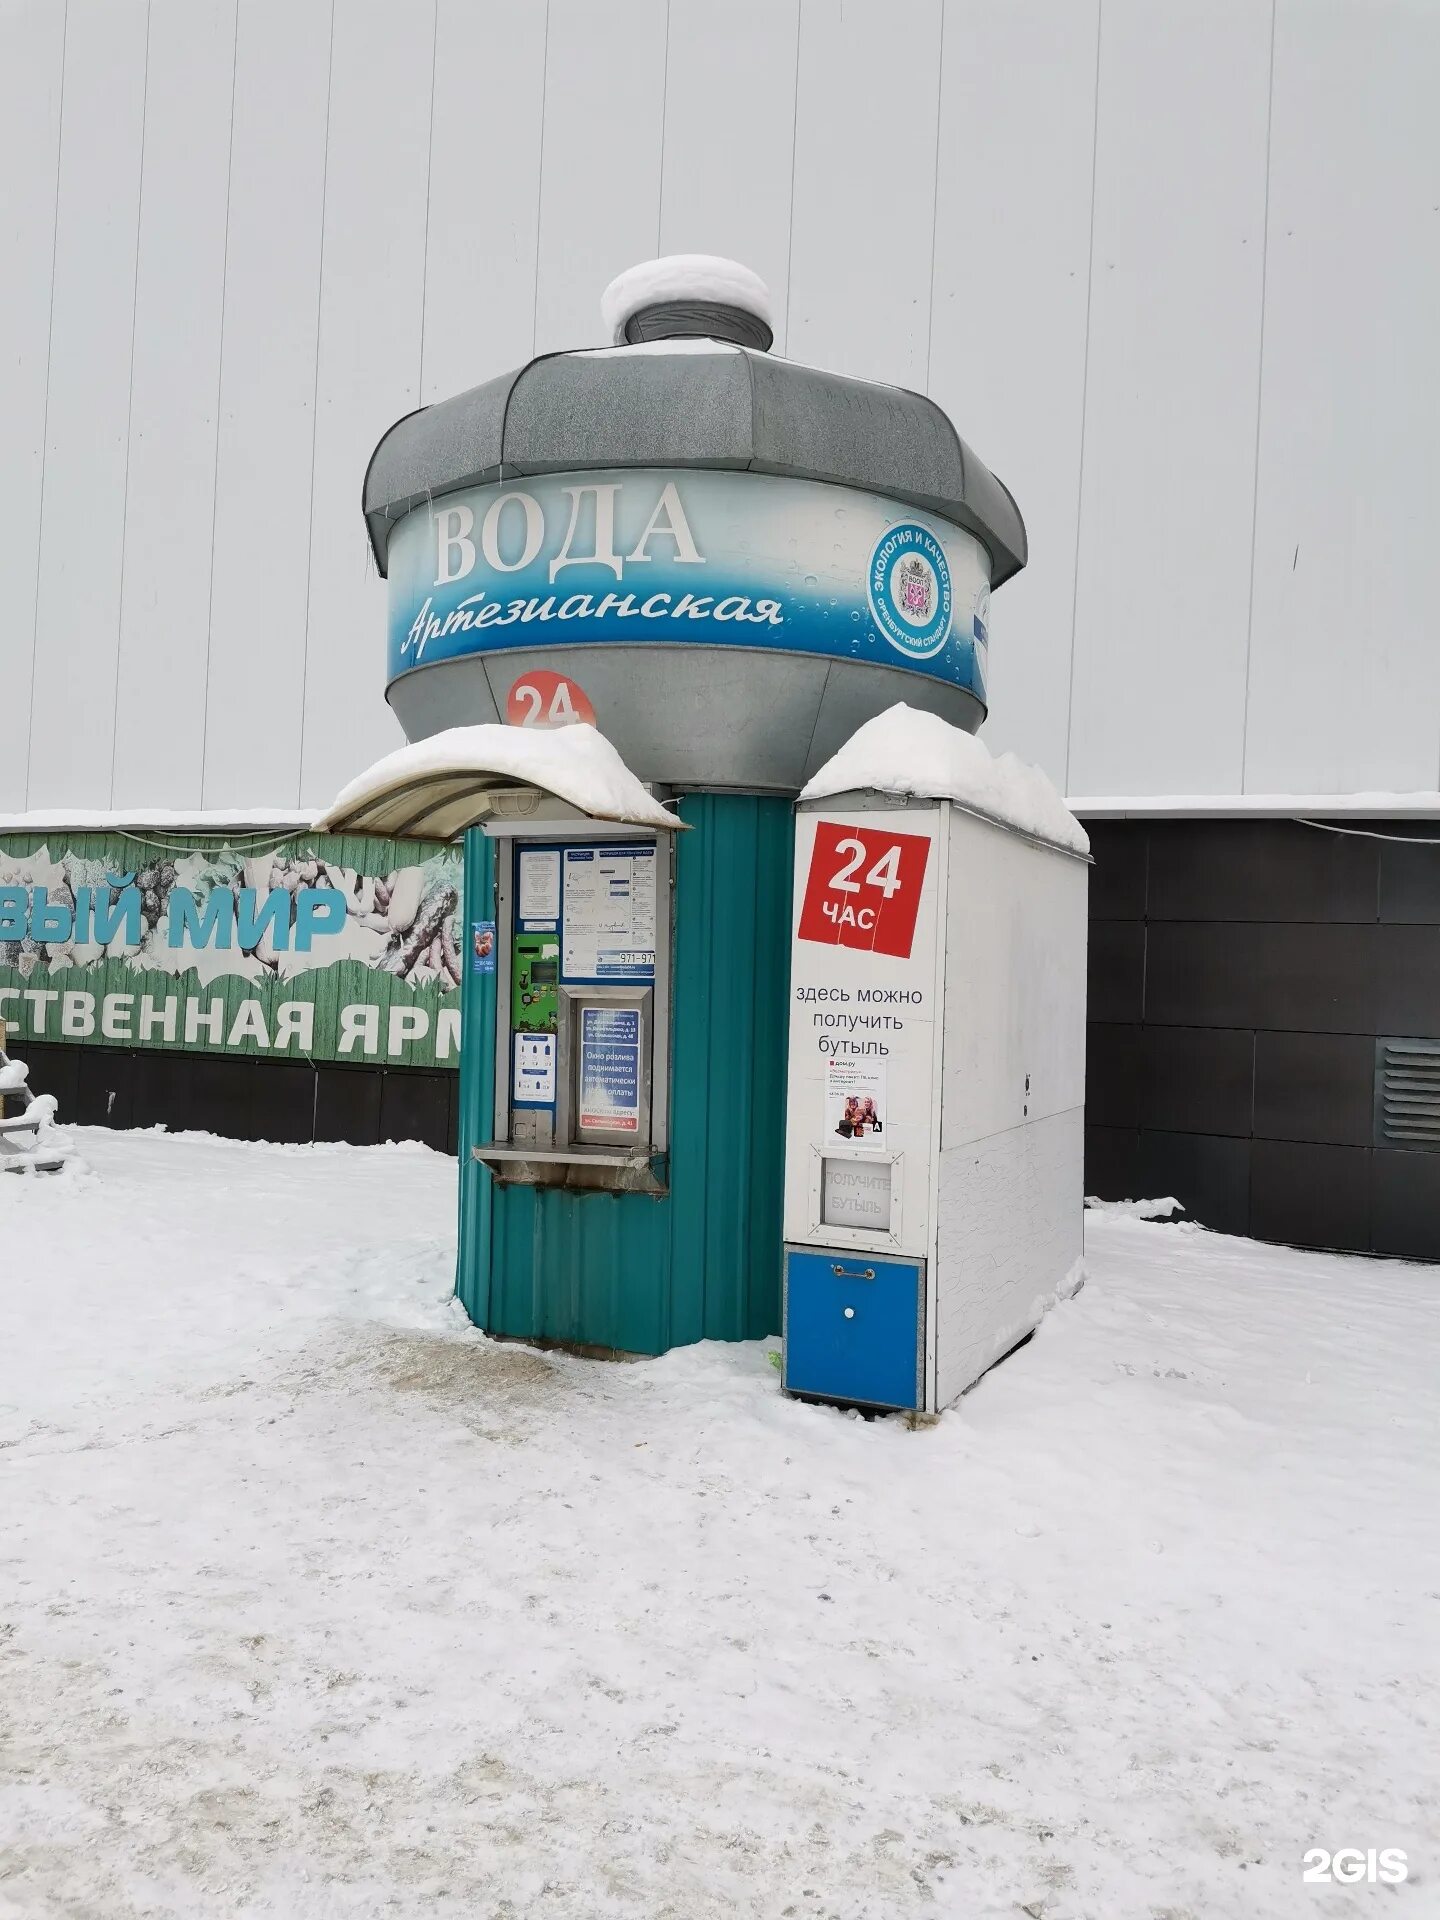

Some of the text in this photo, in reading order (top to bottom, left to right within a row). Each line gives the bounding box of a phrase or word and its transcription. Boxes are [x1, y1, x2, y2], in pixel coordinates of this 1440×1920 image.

[433, 482, 706, 588] ВОДА
[874, 530, 950, 613] ЭКОЛОГИЯ И КАЧЕСТВО
[400, 591, 784, 659] Артезианская
[877, 598, 947, 648] ОРЕНБУРГСКИЙ СТАНДАРТ
[516, 682, 580, 730] 24
[828, 838, 902, 899] 24
[0, 872, 346, 952] ВЫЙ МИР
[822, 901, 877, 930] ЧАС
[796, 987, 923, 1004] здесь можно
[813, 1013, 903, 1032] получить
[586, 1051, 634, 1062] Окно розлива
[818, 1035, 889, 1056] бутыль
[584, 1076, 636, 1085] автоматически
[587, 1064, 633, 1073] поднимается
[607, 1089, 634, 1097] оплаты
